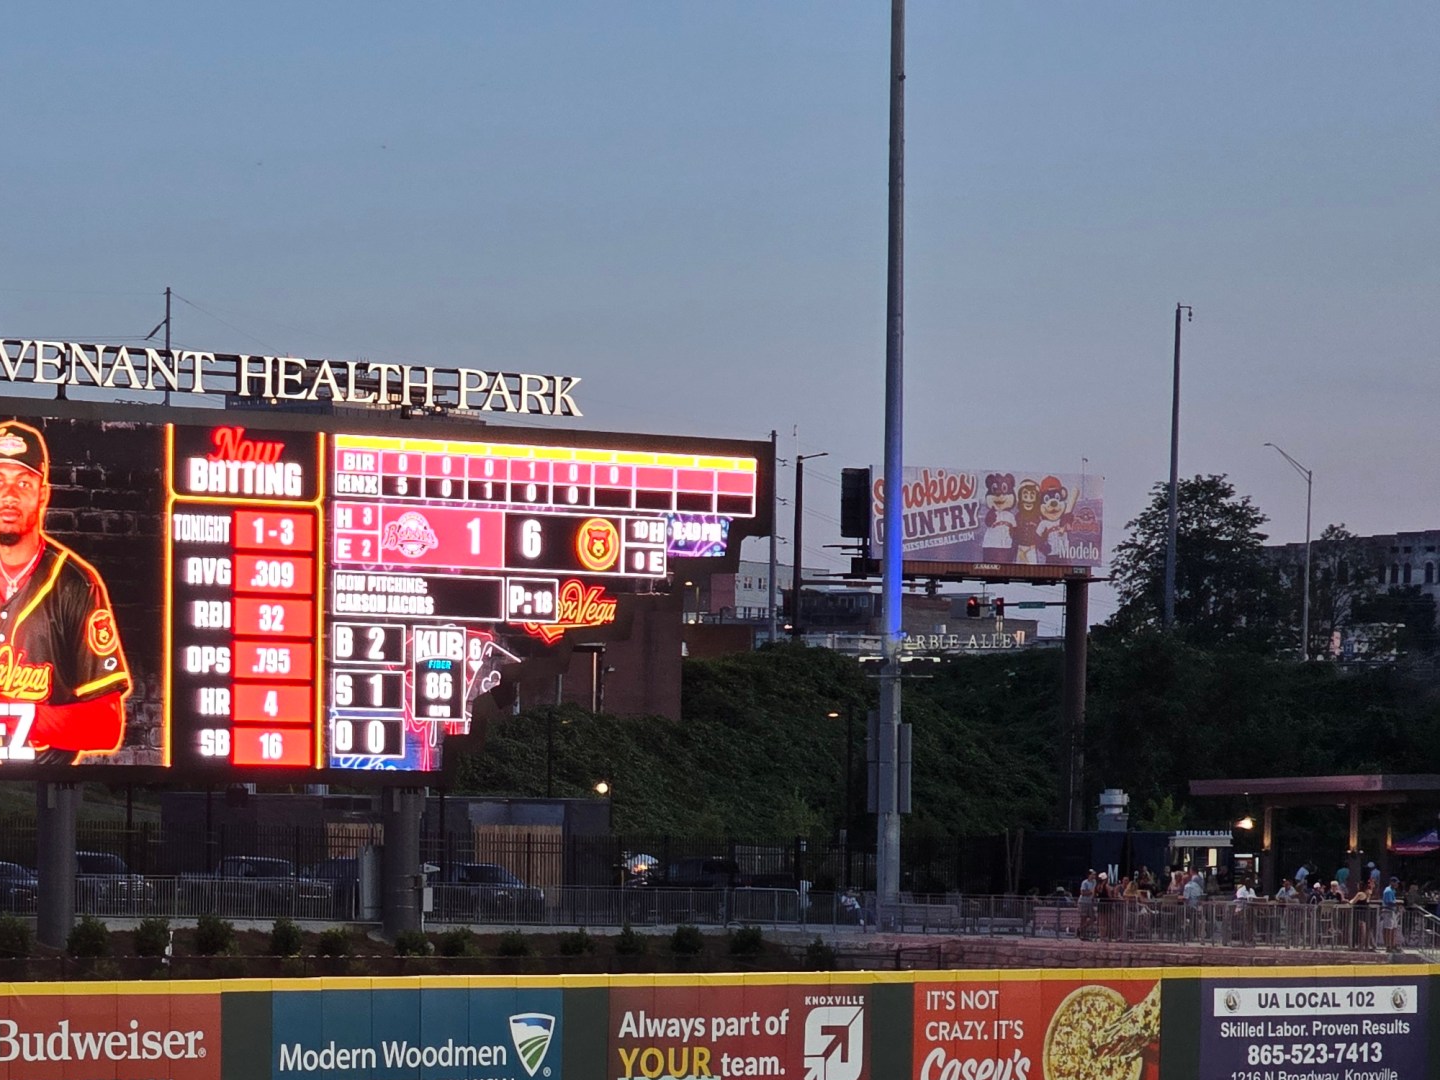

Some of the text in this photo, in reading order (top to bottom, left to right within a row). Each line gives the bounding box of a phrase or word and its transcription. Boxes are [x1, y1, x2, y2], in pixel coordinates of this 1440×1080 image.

[238, 354, 436, 407] HEALTH
[458, 368, 584, 417] PARK
[209, 426, 285, 462] Now
[190, 457, 302, 496] BATTING
[342, 452, 619, 484] BIR 0 0 0 1 0 0
[337, 473, 578, 504] KNX 5 0 1 0 0
[173, 514, 231, 543] TONIGHT
[336, 507, 372, 529] H 3
[633, 520, 664, 543] 10 H
[875, 501, 978, 544] CUNTRY
[337, 538, 371, 559] E 2
[466, 517, 481, 555] 1
[522, 518, 542, 559] 6
[1059, 541, 1100, 560] Modelo
[187, 557, 294, 588] AVG .309
[634, 551, 664, 571] 0 E
[336, 574, 428, 594] NOW PITCHING:
[510, 585, 553, 615] P: 18
[194, 600, 285, 631] RBI 32
[336, 627, 385, 659] B 2
[416, 629, 463, 660] KUB
[469, 637, 481, 660] 6
[905, 634, 1024, 650] ARBLE ALLEY
[186, 646, 290, 674] OPS .795
[427, 659, 452, 670] FIBER
[336, 675, 383, 706] S 1
[426, 672, 453, 700] 86
[199, 687, 278, 717] HR 4
[200, 728, 283, 760] SB 16
[804, 996, 864, 1006] KNOXVILLE
[926, 989, 999, 1011] IT'S NOT
[1258, 991, 1375, 1009] UA LOCAL 102
[618, 1008, 790, 1043] Always part of
[925, 1019, 1024, 1041] CRAZY. IT'S
[1220, 1019, 1410, 1038] Skilled Labor. Proven Results
[279, 1038, 507, 1072] Modern Woodmen
[618, 1046, 786, 1080] YOUR team.
[1247, 1042, 1383, 1066] 865-523-7413
